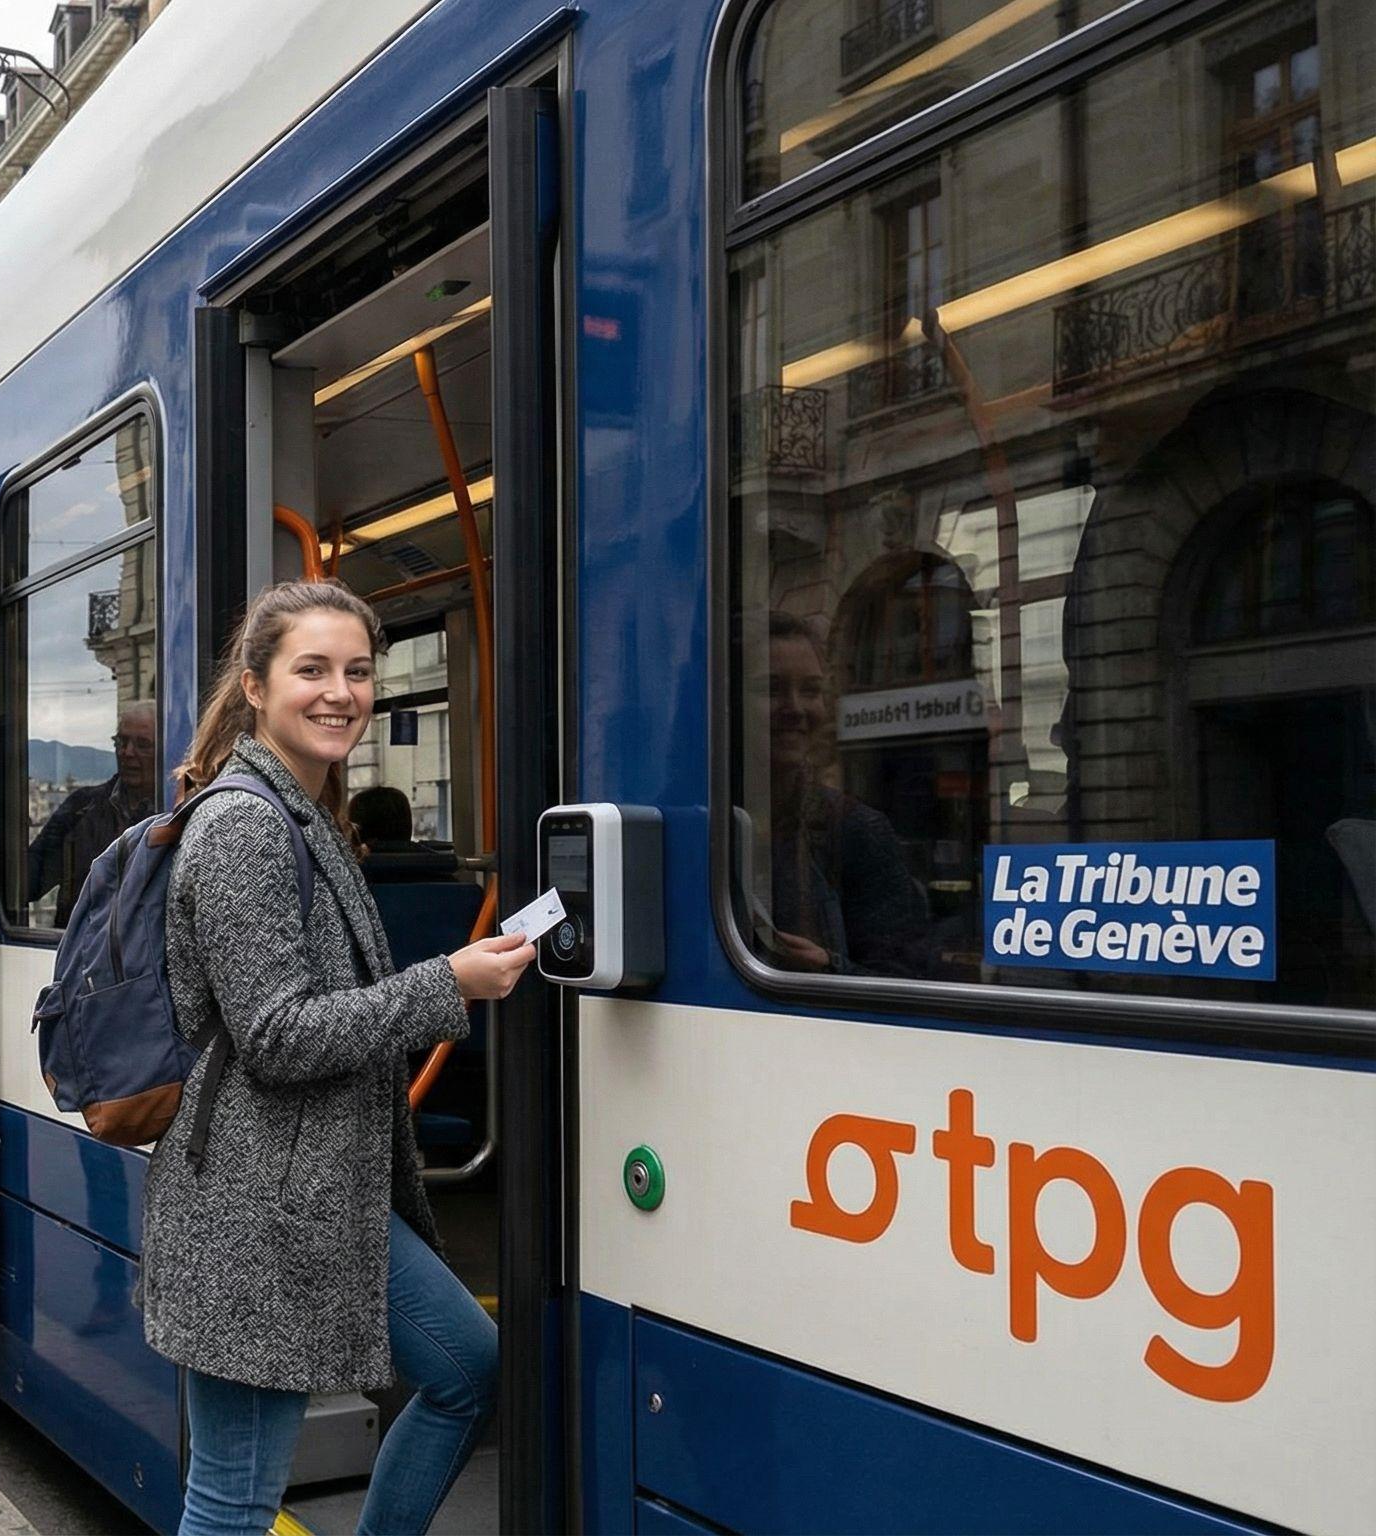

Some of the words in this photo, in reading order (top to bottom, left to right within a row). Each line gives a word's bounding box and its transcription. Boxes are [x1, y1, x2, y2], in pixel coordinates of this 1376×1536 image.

[992, 856, 1049, 903] La
[1056, 852, 1262, 908] Tribune
[993, 907, 1054, 958] de
[1059, 909, 1265, 968] Genève
